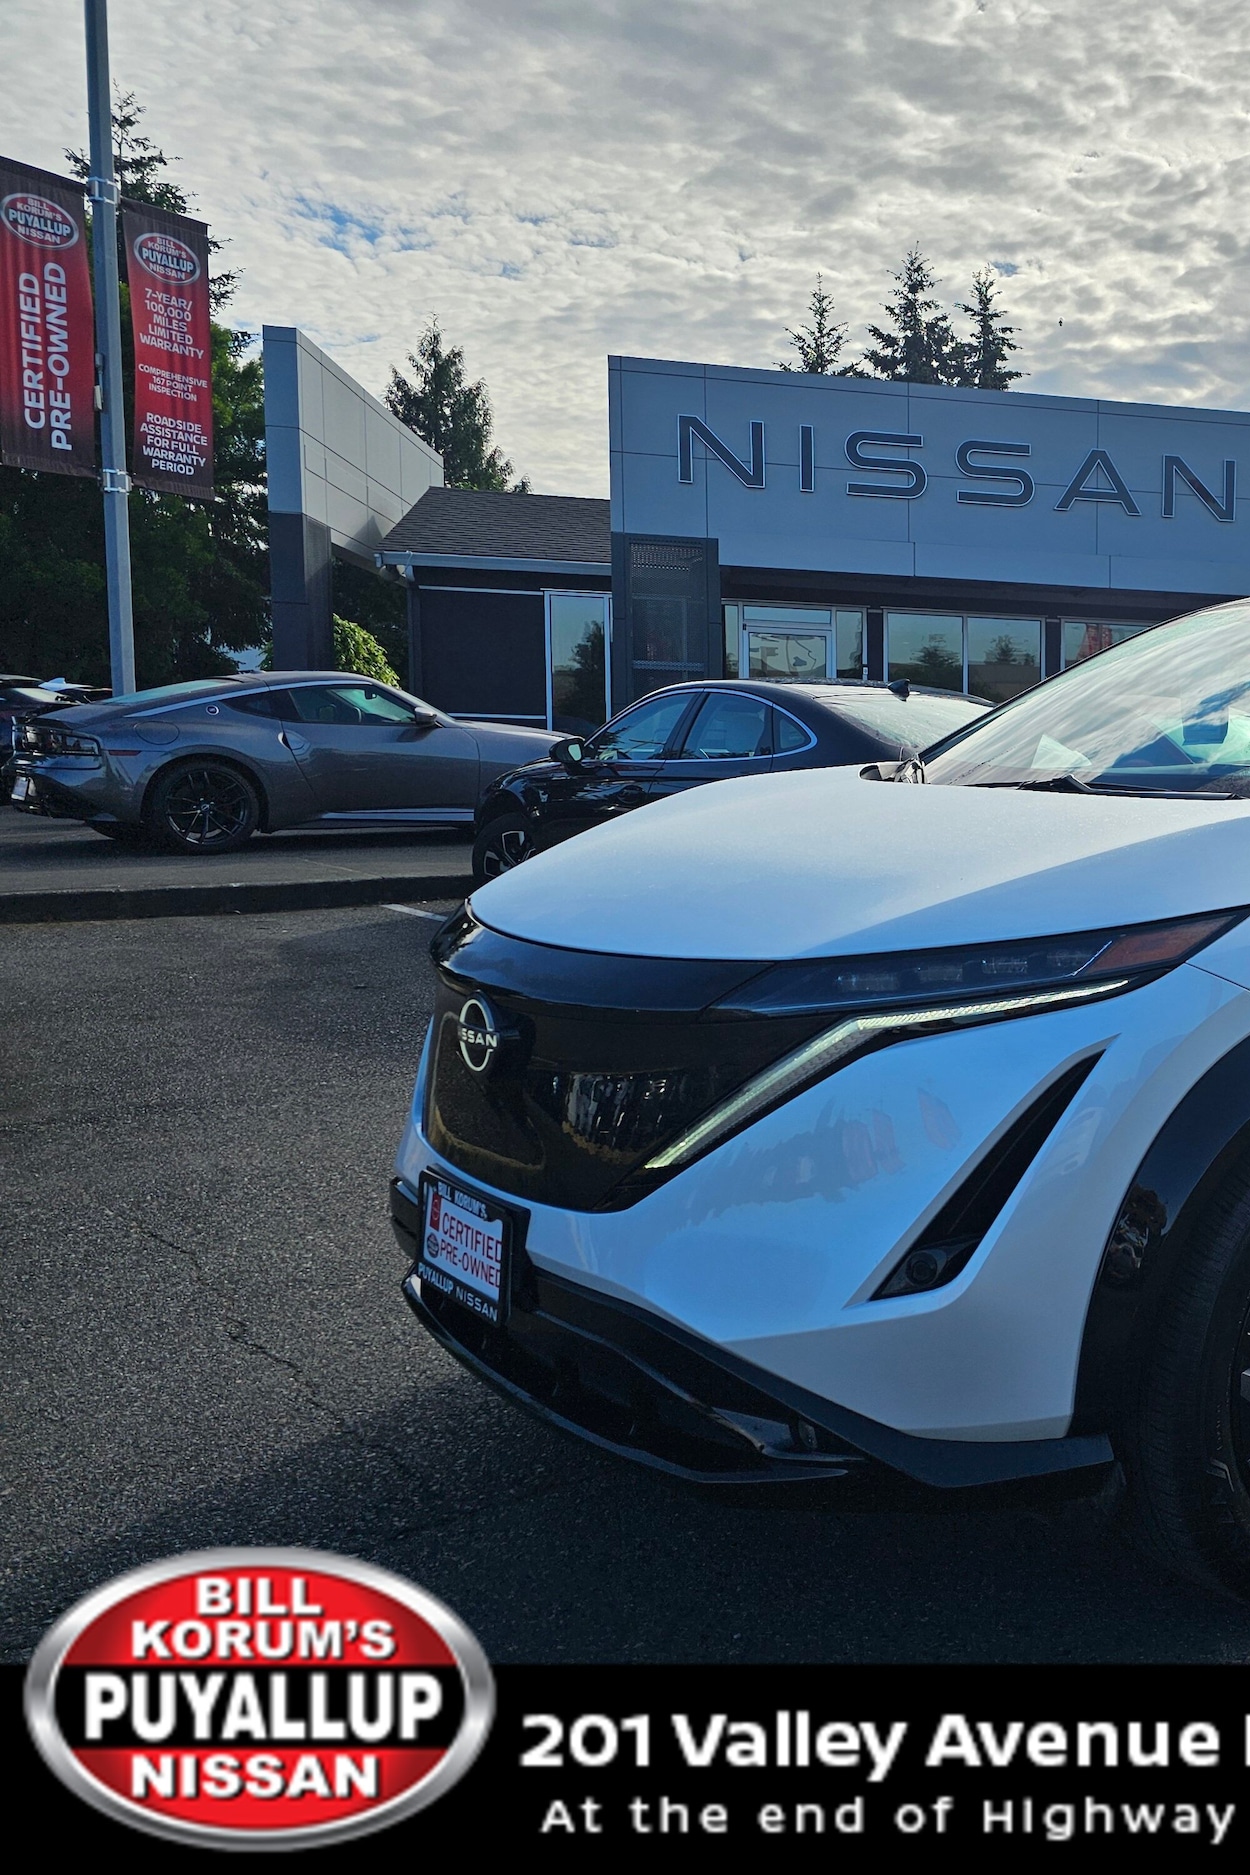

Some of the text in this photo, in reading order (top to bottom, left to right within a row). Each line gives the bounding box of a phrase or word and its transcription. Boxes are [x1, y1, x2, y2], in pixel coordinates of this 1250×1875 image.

[16, 202, 62, 221] KORUM'S
[27, 198, 50, 211] BILL
[8, 208, 71, 237] PUYALLUP
[17, 225, 60, 244] NISSAN
[156, 237, 176, 249] BILL
[142, 247, 194, 273] PUYALLUP
[148, 241, 187, 259] KORUM'S
[149, 262, 186, 280] NISSAN
[145, 287, 192, 311] 7-YEAR/
[145, 300, 192, 322] 100,000
[153, 313, 187, 332] MILES
[148, 323, 193, 345] LIMITED
[18, 272, 46, 429] CERTIFIED
[43, 262, 72, 451] PRE-OWNED
[139, 332, 204, 360] WARRANTY
[138, 363, 208, 388] COMPREHENSIVE
[152, 375, 193, 392] 167 POINT
[149, 383, 198, 402] INSPECTION
[140, 422, 208, 446] ASSISTANCE
[146, 412, 202, 434] ROADSIDE
[142, 445, 206, 468] WARRANTY
[147, 435, 199, 456] FOR FULL
[151, 458, 195, 476] PERIOD
[676, 413, 1237, 523] NISSAN
[442, 1211, 502, 1264] CERTIFIED
[440, 1238, 500, 1289] PRE-OWNED
[417, 1261, 498, 1322] PUYALLUP NISSAN
